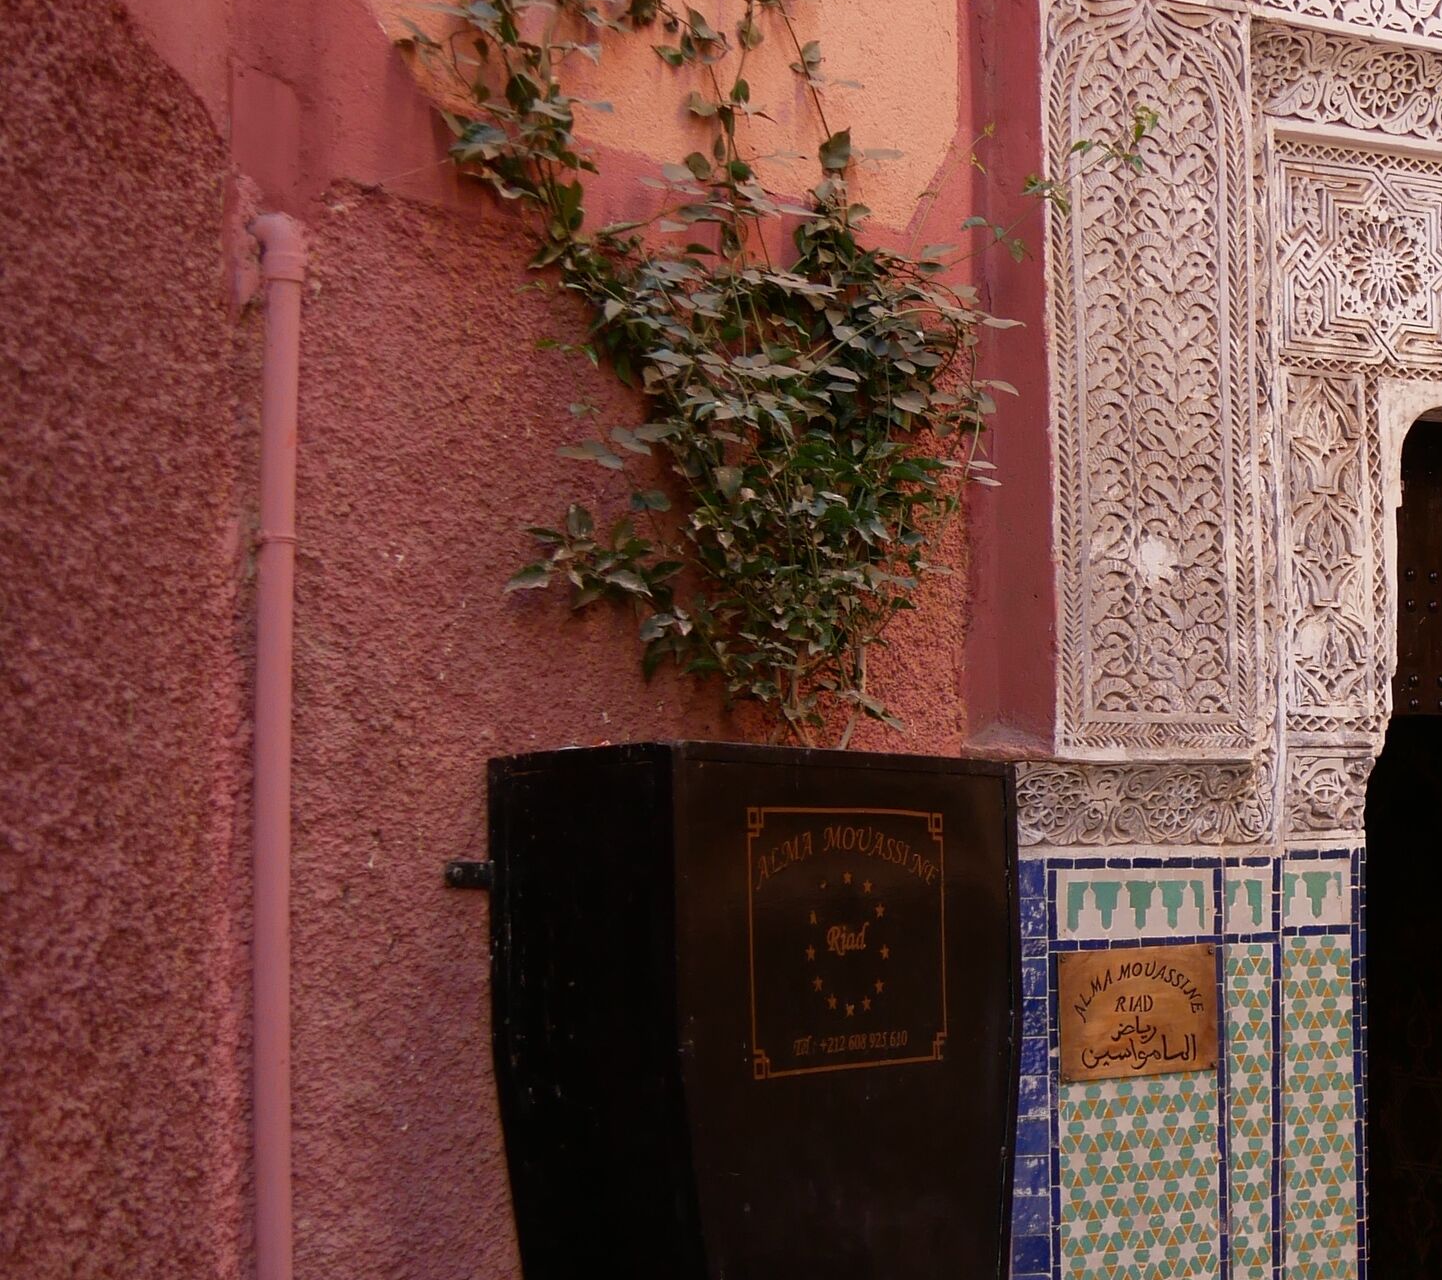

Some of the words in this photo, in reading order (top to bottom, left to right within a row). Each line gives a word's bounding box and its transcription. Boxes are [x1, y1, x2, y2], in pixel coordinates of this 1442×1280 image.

[756, 831, 813, 890] ALMA
[823, 825, 940, 885] MOUASSINE
[827, 922, 869, 956] Riad
[1074, 969, 1112, 1023] ALMA
[1117, 961, 1204, 1014] MOUASSINE
[1114, 995, 1153, 1012] RIAD
[1111, 1015, 1157, 1044] رياض
